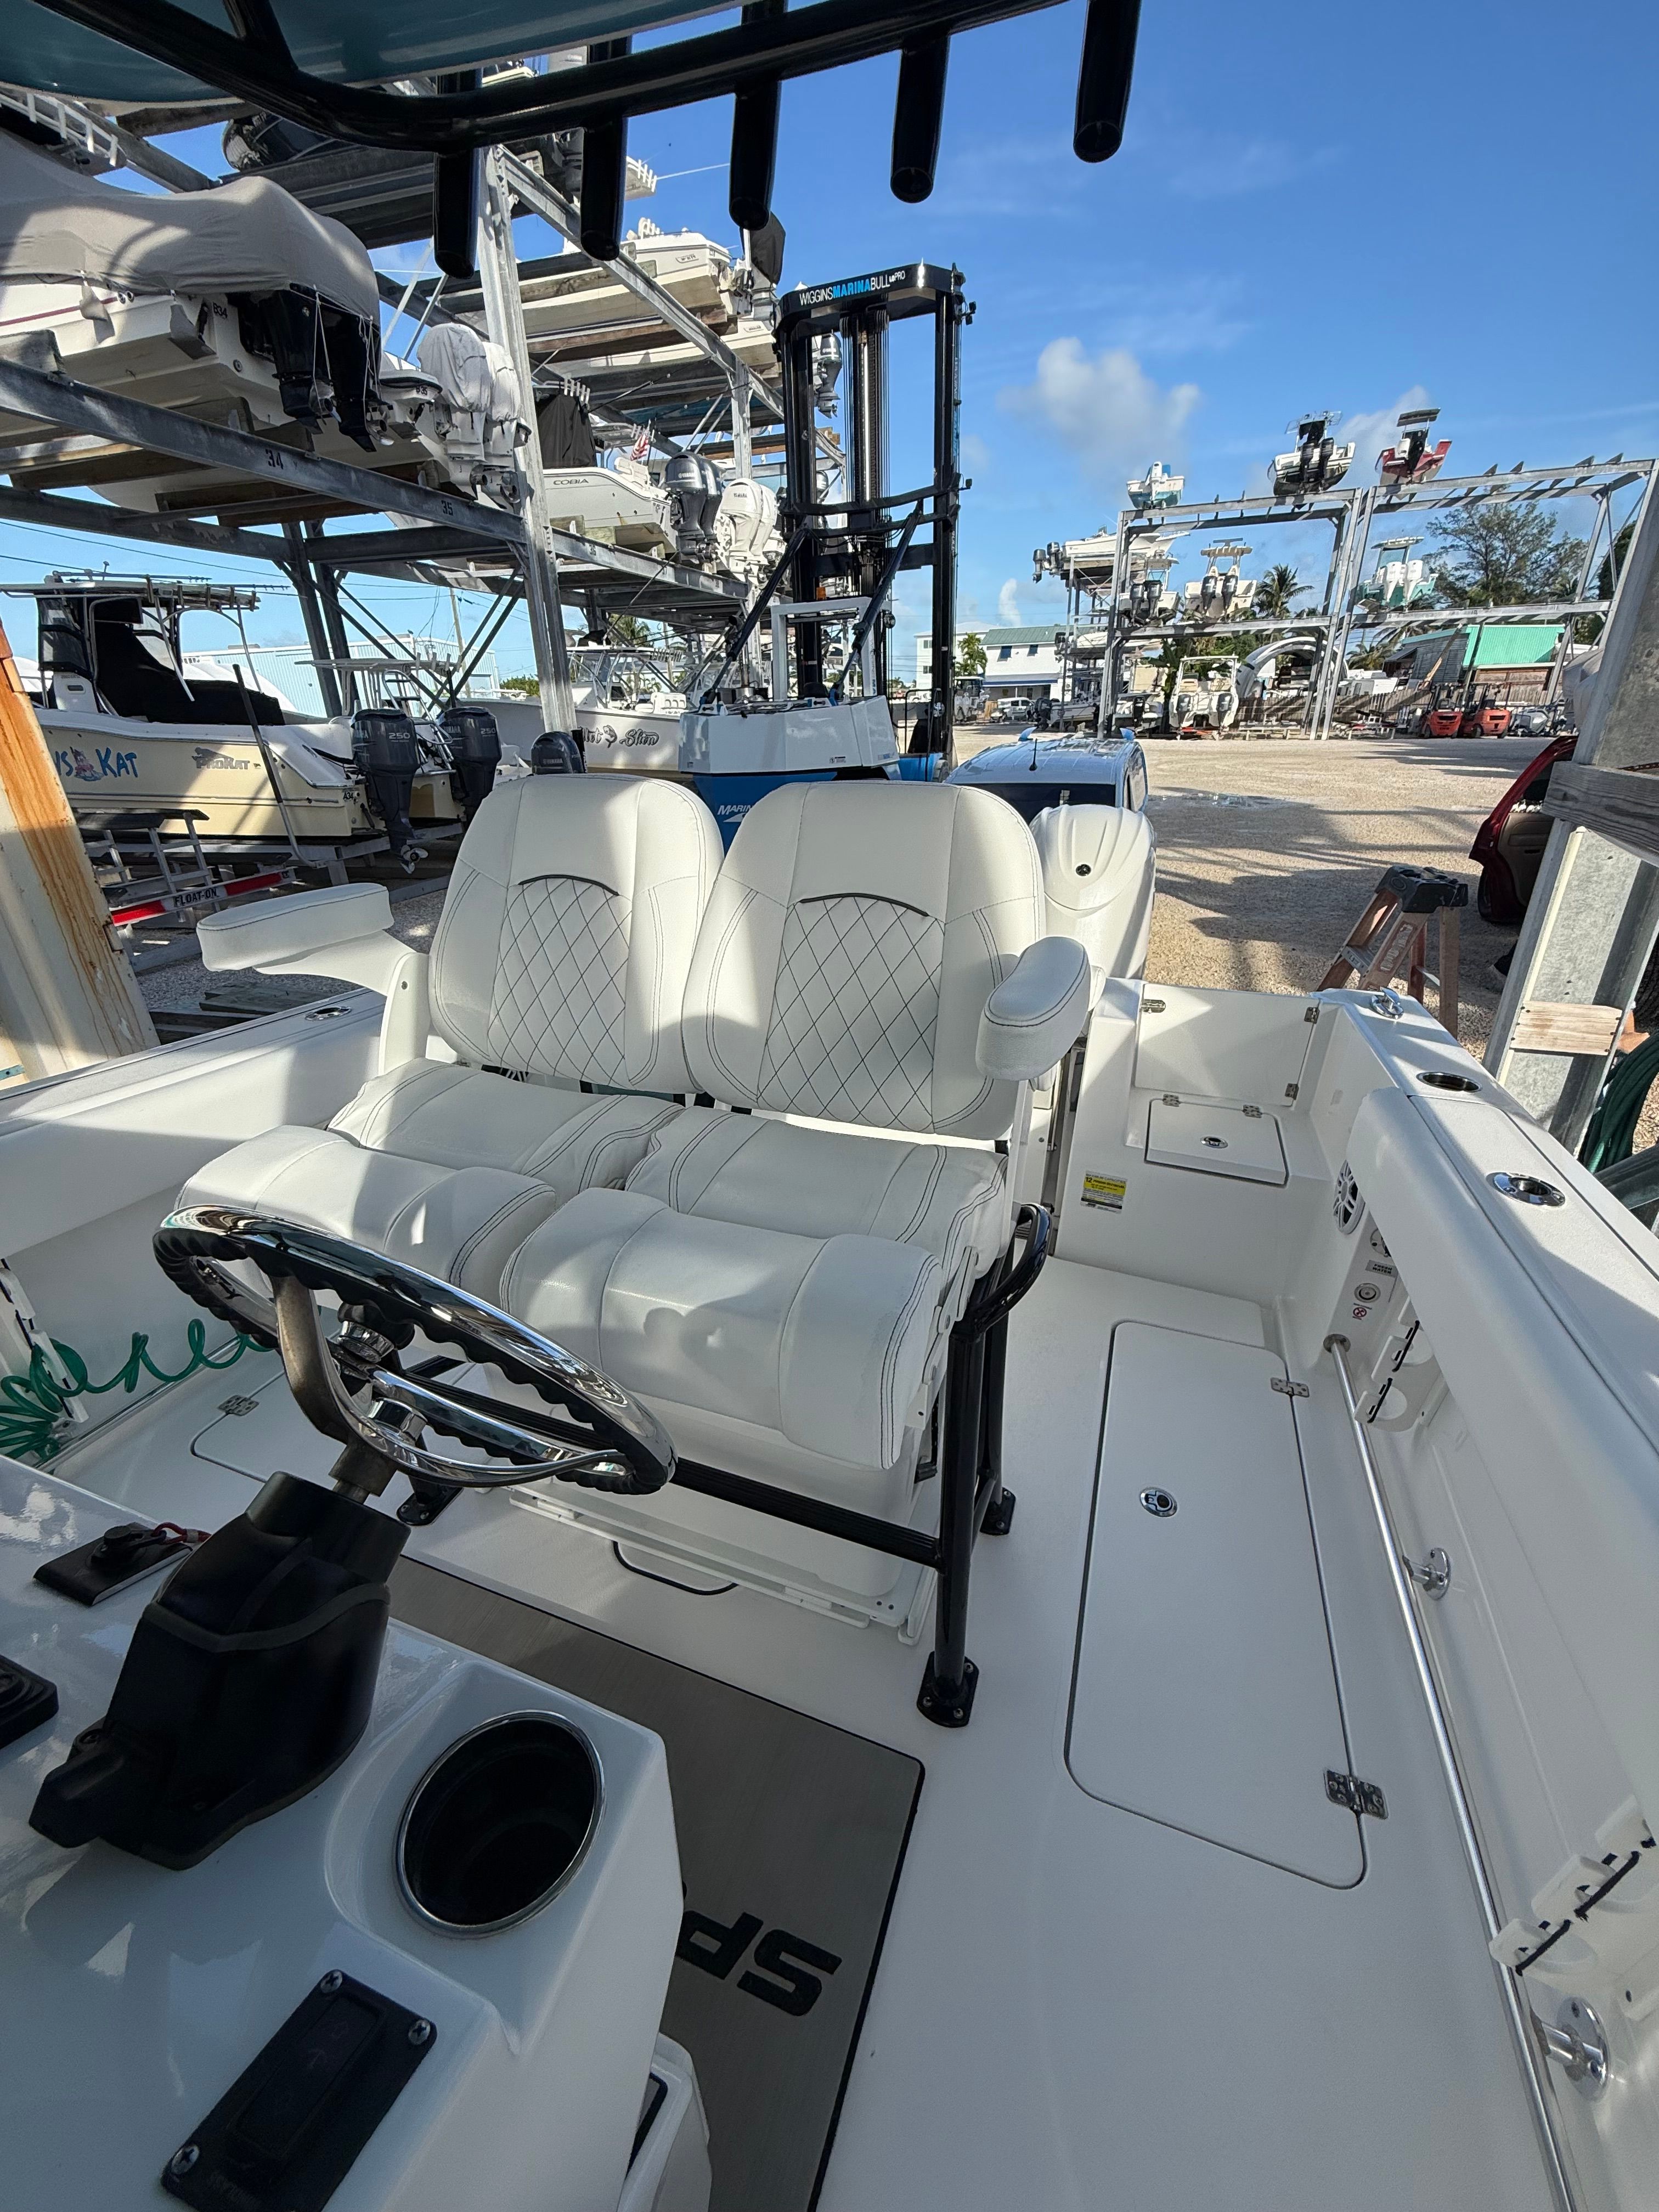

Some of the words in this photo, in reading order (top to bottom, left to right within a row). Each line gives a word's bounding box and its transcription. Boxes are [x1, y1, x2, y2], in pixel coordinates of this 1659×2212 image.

[212, 302, 228, 318] B34
[266, 449, 284, 470] 34
[441, 500, 454, 516] 35
[95, 747, 138, 778] KAT
[717, 805, 755, 815] MARIN
[173, 888, 217, 907] FLOAT-ON
